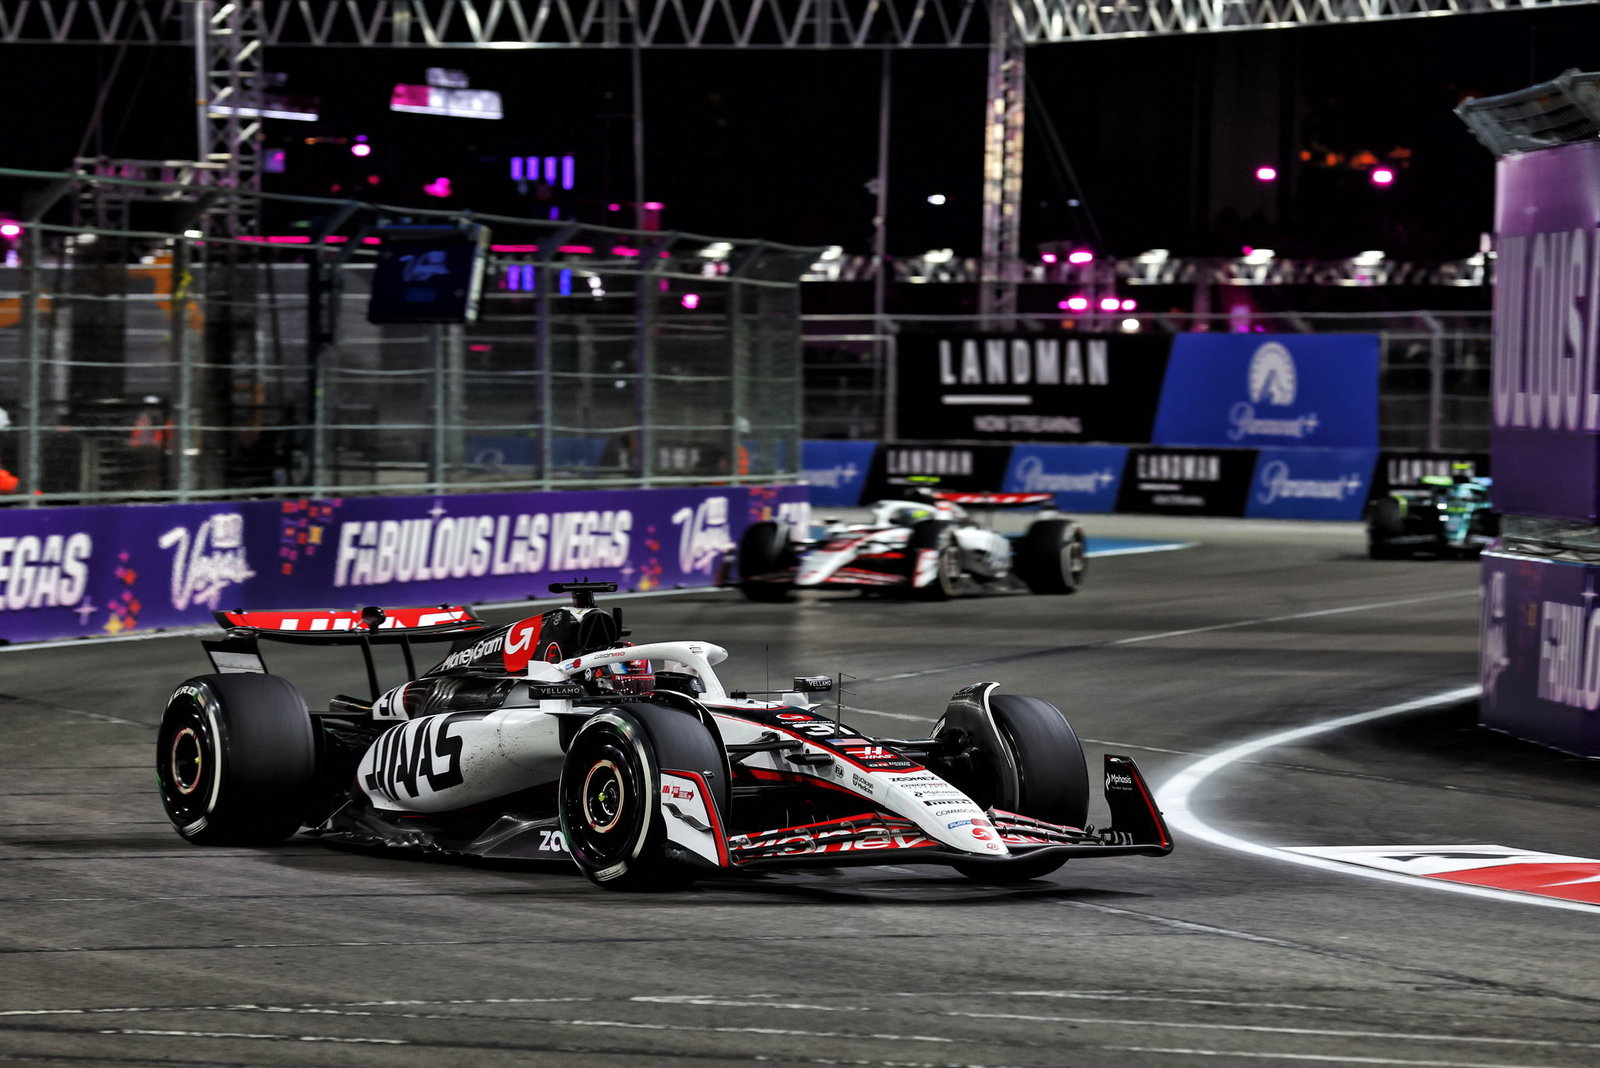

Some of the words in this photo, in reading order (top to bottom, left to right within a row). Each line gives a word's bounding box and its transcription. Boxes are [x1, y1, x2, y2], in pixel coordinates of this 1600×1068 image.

[939, 339, 1109, 385] LANDMAN
[886, 450, 973, 475] LANDMAN
[1136, 454, 1220, 481] LANDMAN
[333, 515, 495, 588] FABULOUS
[490, 513, 549, 576] LAS
[548, 509, 633, 572] VEGAS
[0, 532, 92, 611] EGAS
[440, 636, 504, 672] MoneyGram
[541, 686, 580, 695] VELLAMO
[808, 679, 832, 687] VELLAMO
[1110, 773, 1132, 786] Mphasis
